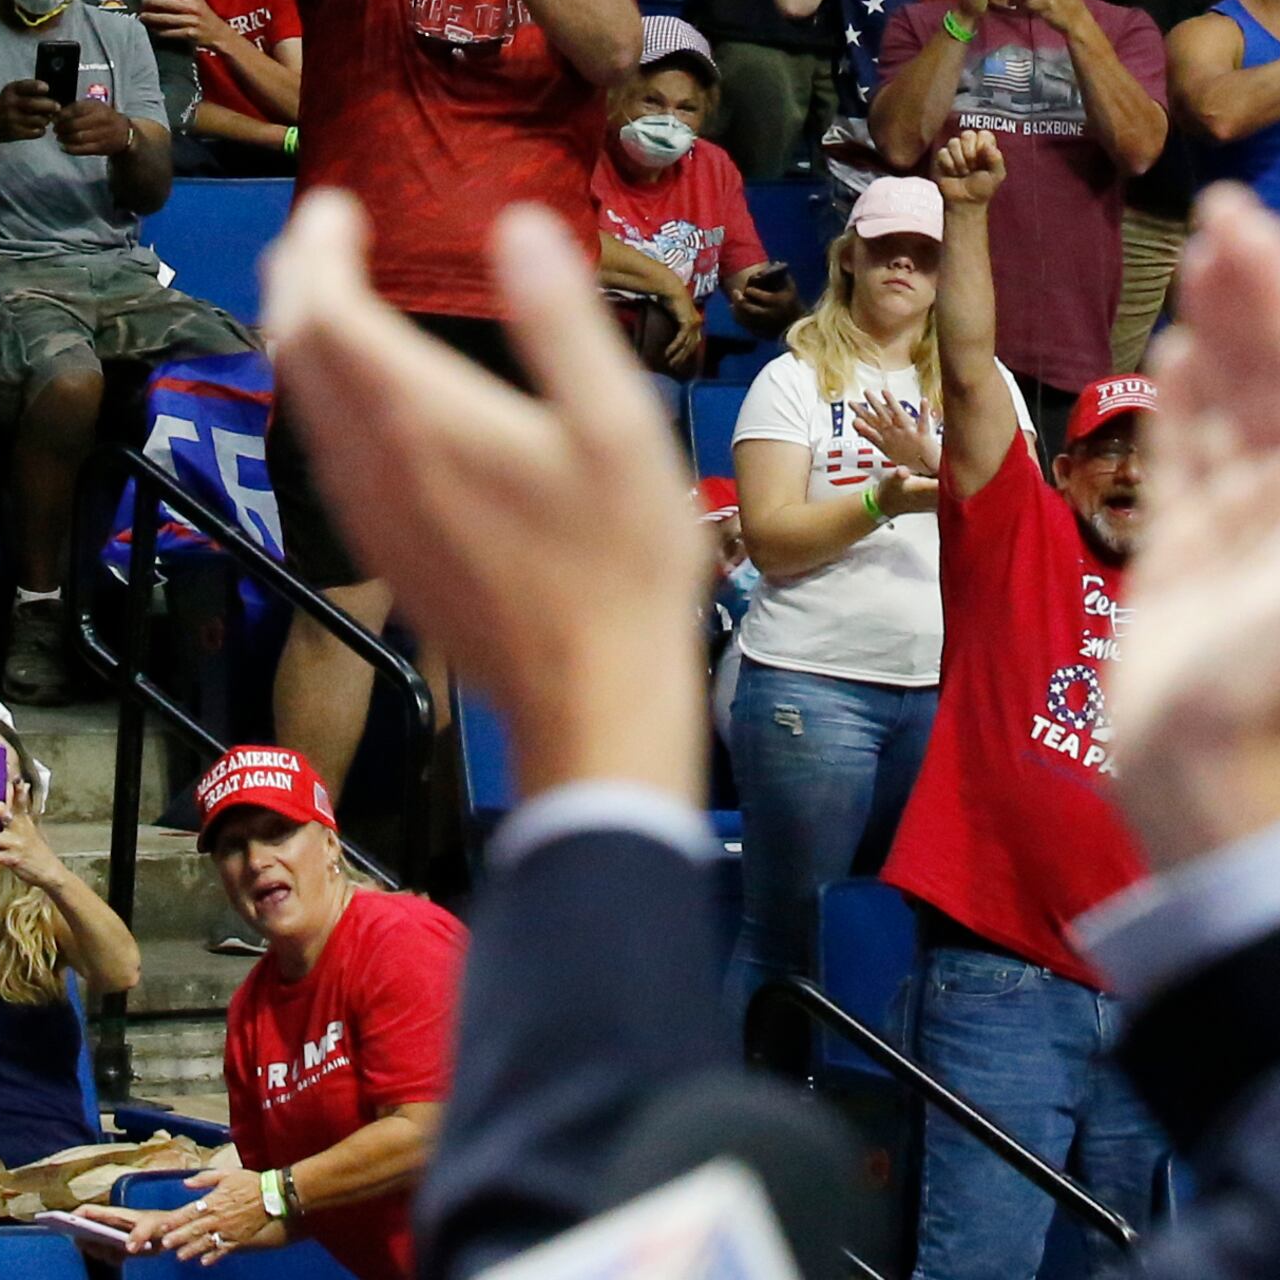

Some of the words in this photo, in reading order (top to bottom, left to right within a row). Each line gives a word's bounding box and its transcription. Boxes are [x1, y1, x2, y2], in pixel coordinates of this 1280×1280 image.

[959, 114, 1017, 134] AMERICAN
[1023, 120, 1084, 137] BACKBONE
[1031, 714, 1080, 760] TEA
[197, 760, 227, 798] MAKE
[228, 748, 301, 777] AMERICA
[202, 778, 244, 812] GREAT
[244, 772, 294, 796] AGAIN
